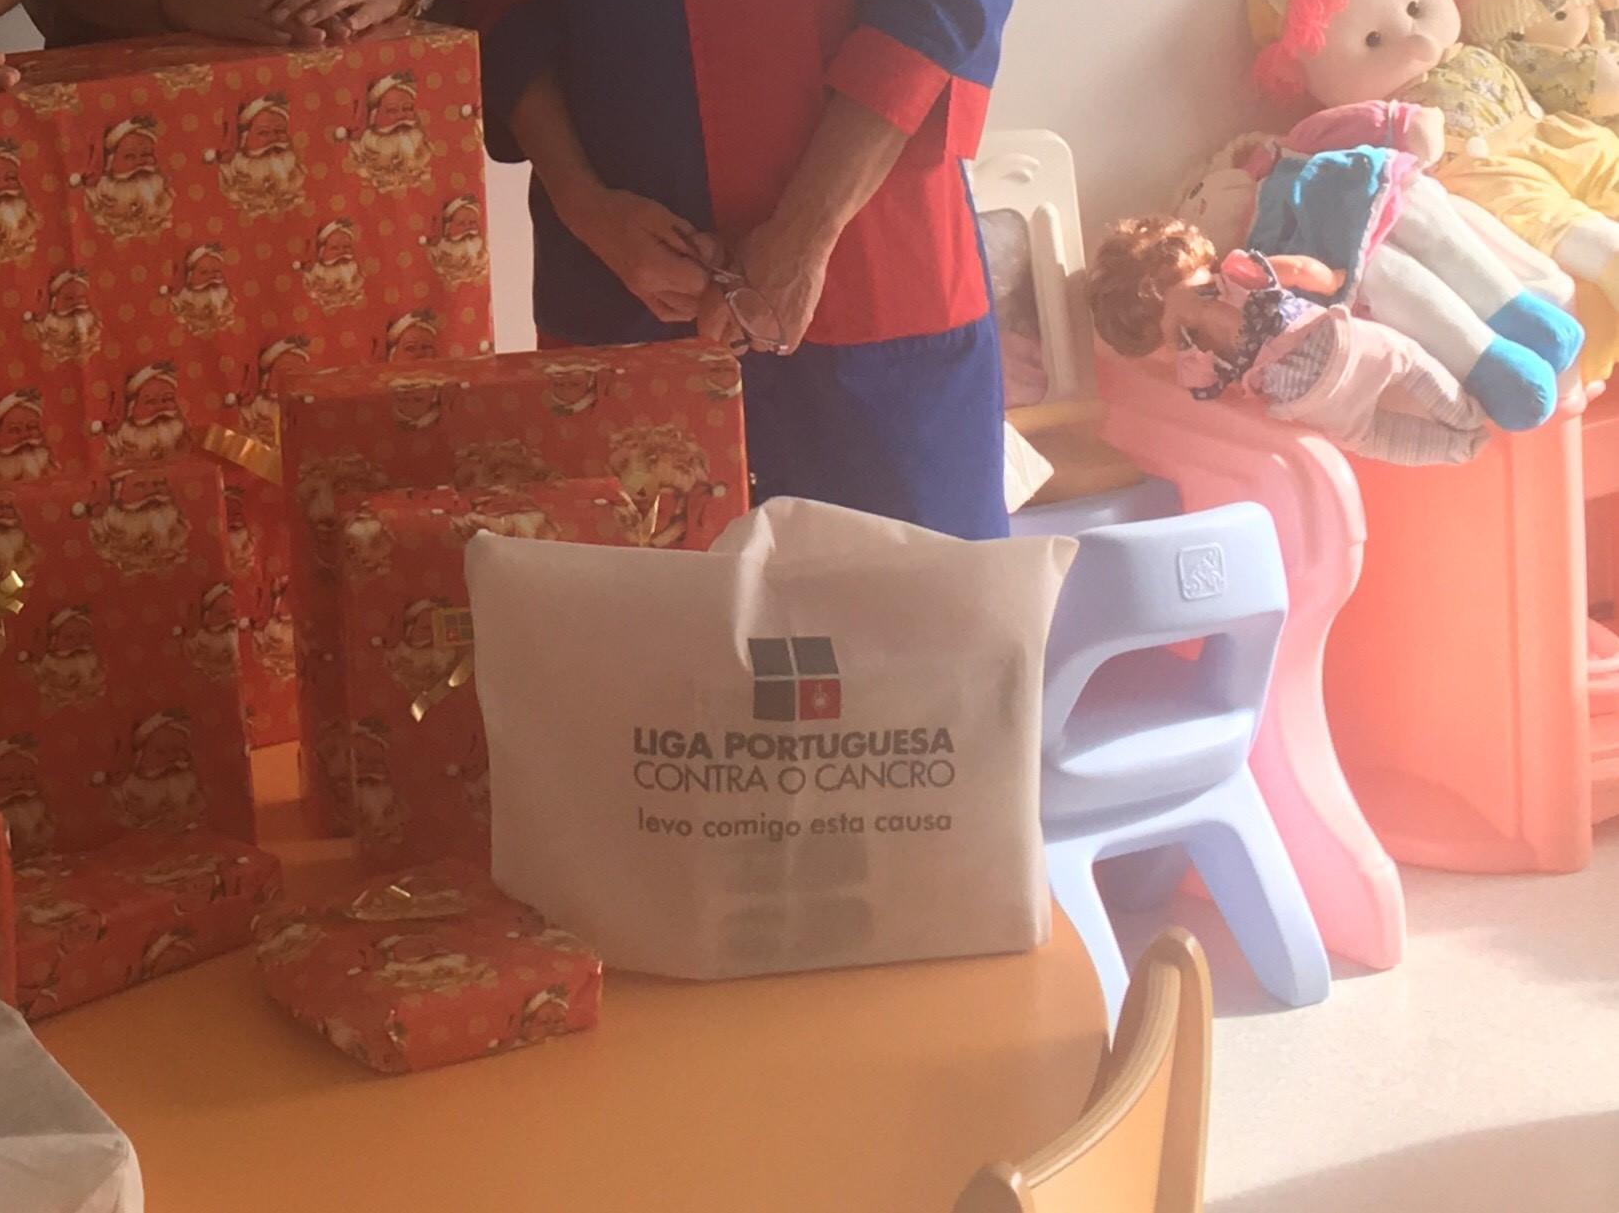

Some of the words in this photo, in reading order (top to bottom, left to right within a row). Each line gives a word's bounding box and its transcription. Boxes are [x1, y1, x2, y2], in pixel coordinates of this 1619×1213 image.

[634, 727, 713, 759] LIGA
[725, 728, 955, 762] PORTUGUESA
[634, 760, 768, 792] CONTRA
[778, 766, 806, 795] O
[815, 760, 955, 792] CANCRO
[638, 806, 692, 836] levo
[703, 812, 801, 842] comigo
[810, 812, 864, 834] esta
[875, 814, 952, 832] causa
